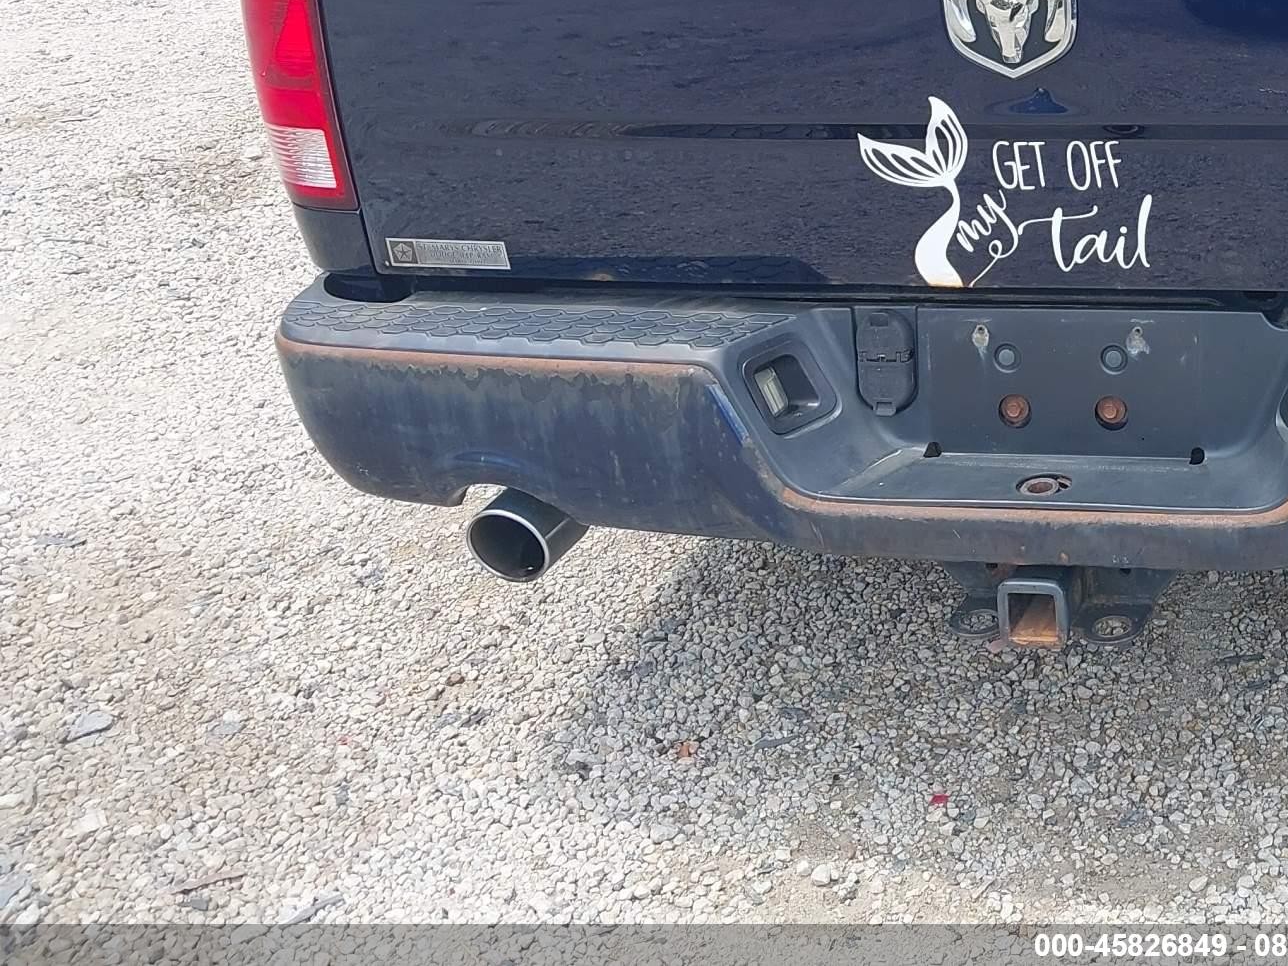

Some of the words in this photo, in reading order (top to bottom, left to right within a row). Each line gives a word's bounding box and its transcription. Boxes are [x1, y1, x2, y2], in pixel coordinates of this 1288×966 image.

[992, 140, 1046, 191] GET
[1066, 140, 1122, 191] OFF
[461, 244, 503, 253] CHRYSLER
[956, 189, 1019, 260] my
[1050, 194, 1152, 272] tail
